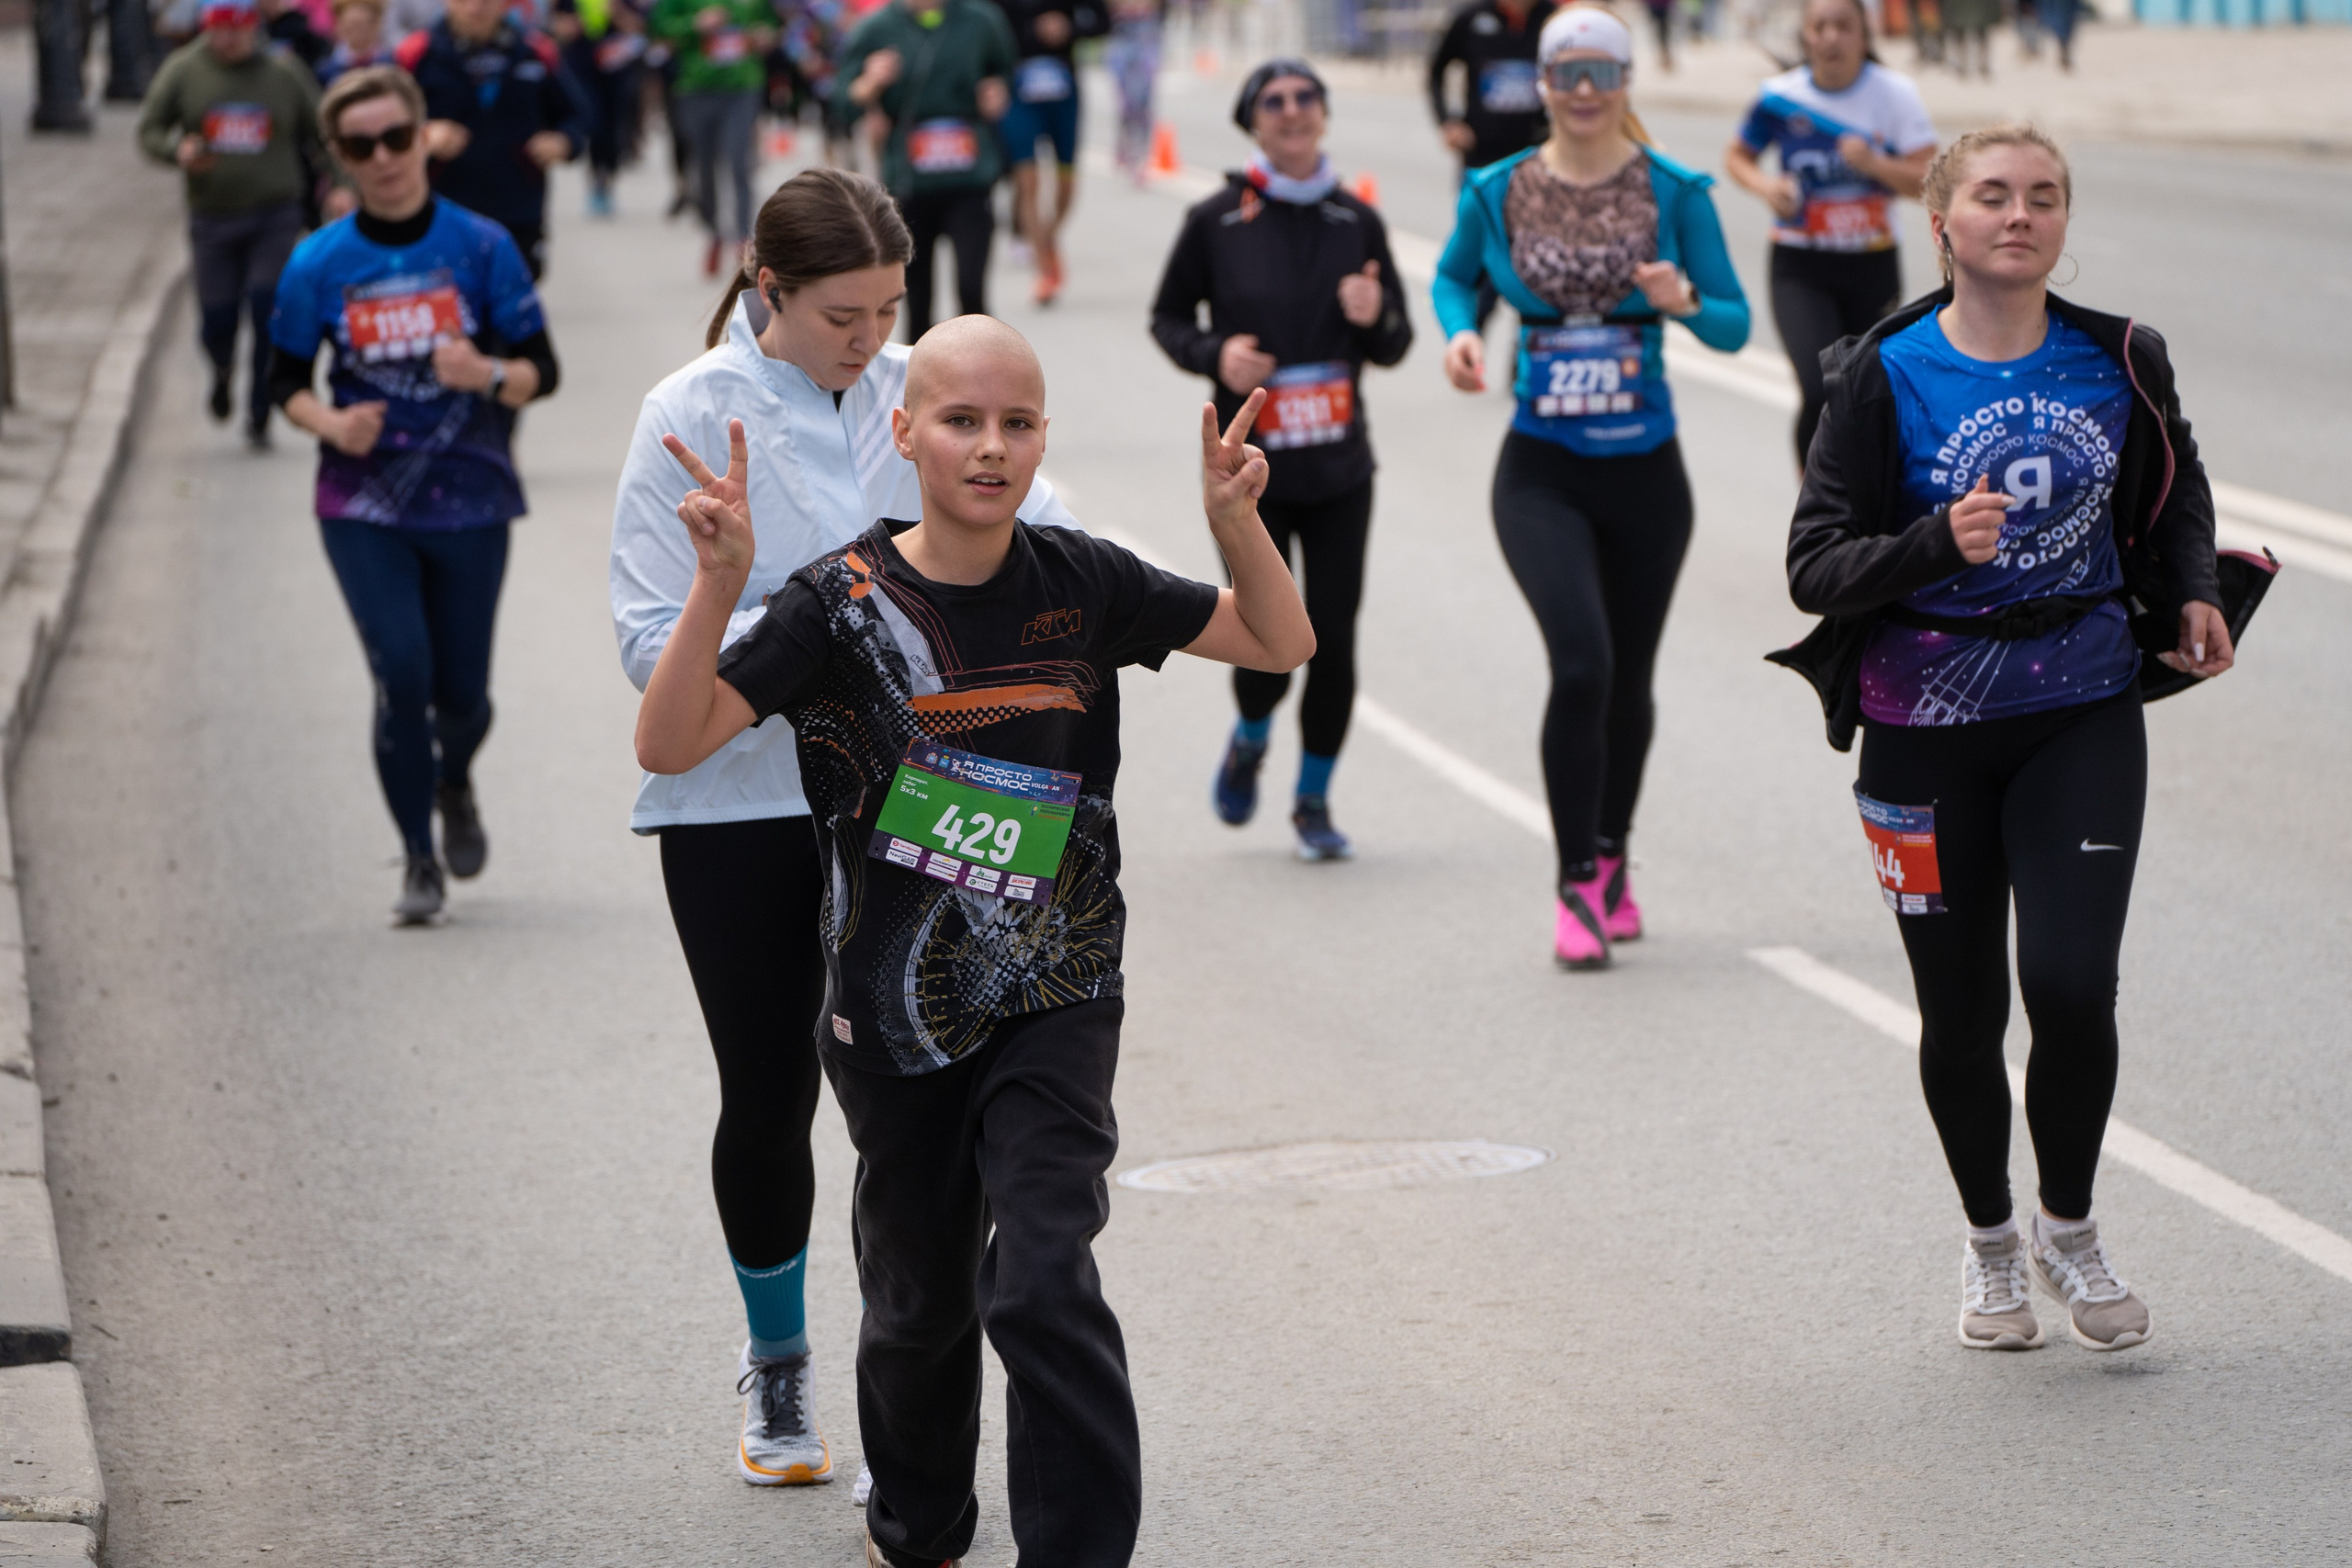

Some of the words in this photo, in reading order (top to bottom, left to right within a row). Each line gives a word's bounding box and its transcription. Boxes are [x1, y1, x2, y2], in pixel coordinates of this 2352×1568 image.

[1548, 357, 1621, 395] 2279
[1936, 397, 2025, 465] ПРОСТО
[2032, 397, 2117, 468] КОСМОС
[2033, 415, 2045, 430] Я
[2051, 418, 2106, 478] ПРОСТО
[1951, 423, 2007, 494] КОСМОС
[2028, 433, 2085, 468] КОСМОС
[1930, 468, 1949, 486] Я
[2004, 455, 2052, 513] Я
[1021, 608, 1080, 645] KTM
[960, 770, 1031, 792] КОСМОС
[963, 761, 975, 770] Я
[975, 763, 1033, 782] ПРОСТО
[931, 804, 1023, 865] 429
[888, 851, 916, 863] NaviGAR
